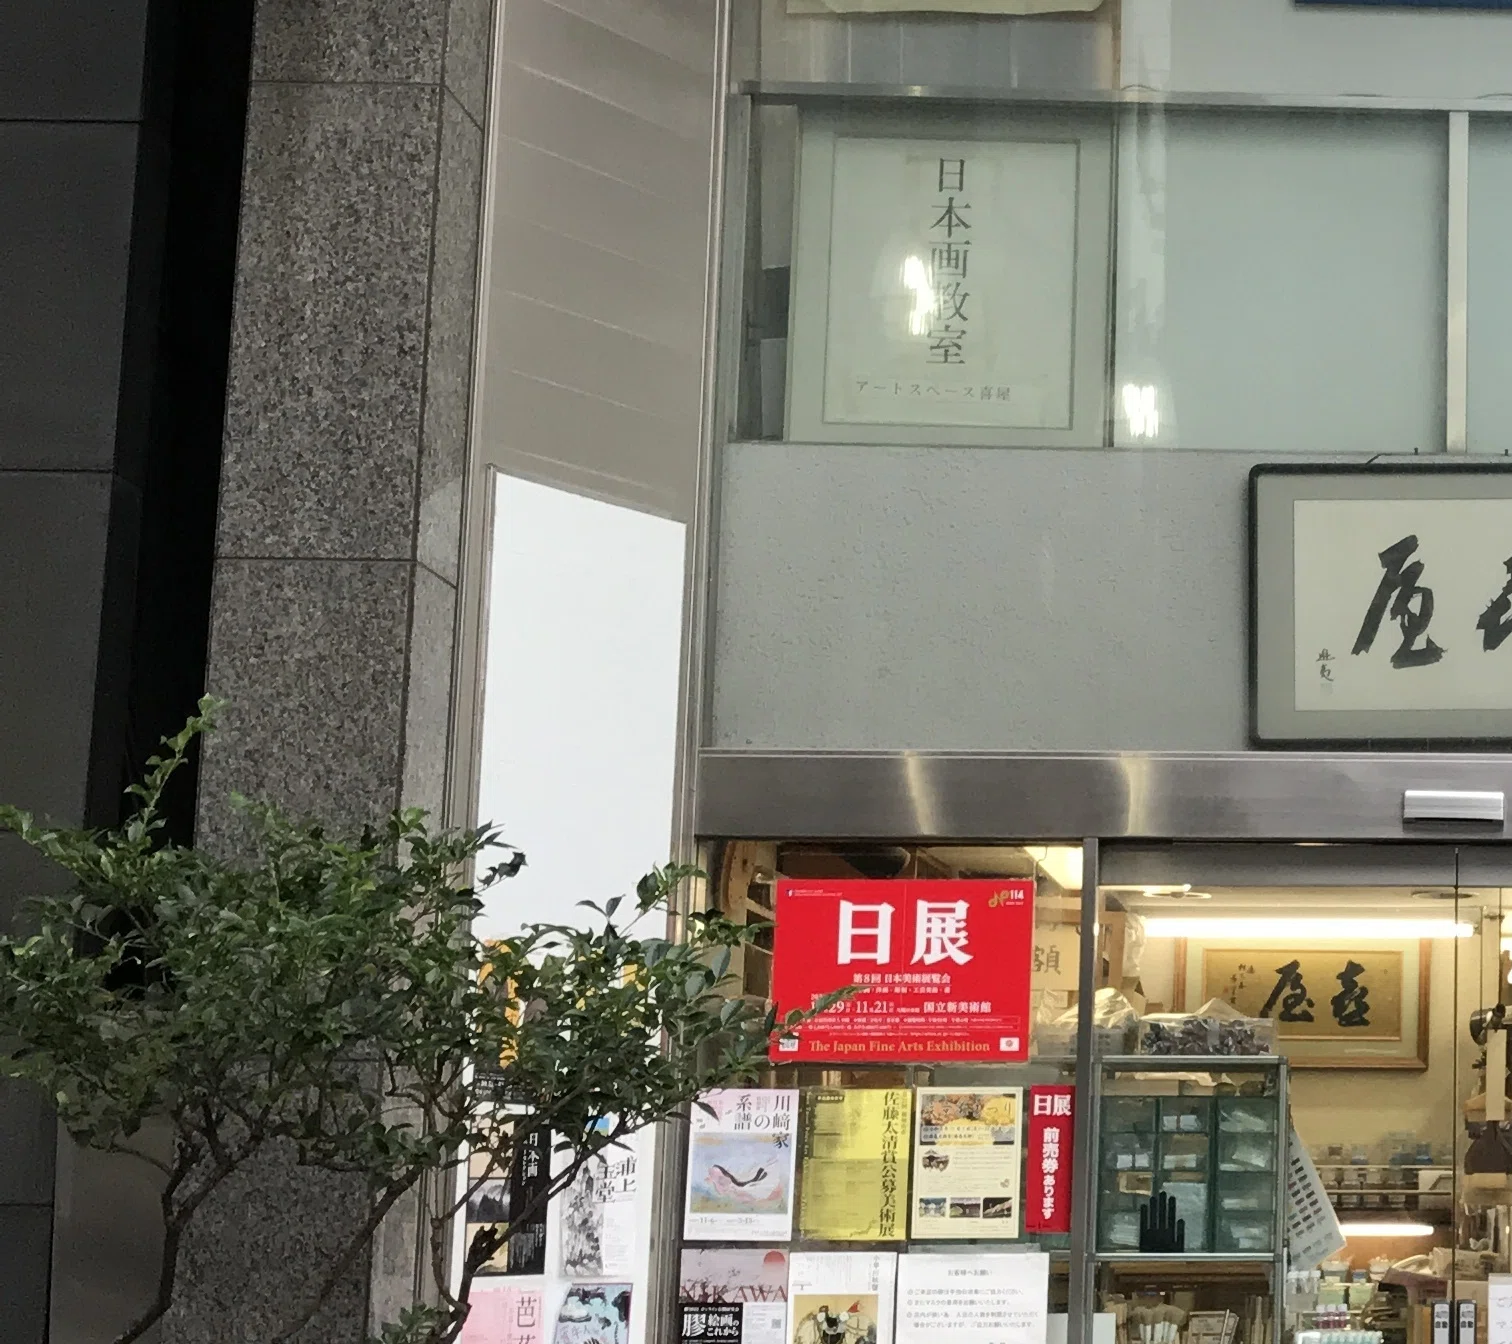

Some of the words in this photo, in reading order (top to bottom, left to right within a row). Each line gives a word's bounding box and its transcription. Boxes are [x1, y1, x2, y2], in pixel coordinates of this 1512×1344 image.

[926, 157, 972, 366] 日本画教室
[837, 899, 974, 966] 日展
[809, 1040, 831, 1052] The
[833, 1040, 867, 1055] Japan
[869, 1040, 896, 1052] Fine
[899, 1040, 924, 1052] Arts
[926, 1040, 990, 1052] Exhibition
[1032, 1093, 1073, 1117] 日展
[1041, 1126, 1060, 1221] 前売券あります
[682, 1313, 706, 1337] 膠
[707, 1327, 739, 1337] これから
[708, 1313, 740, 1327] 絵画の
